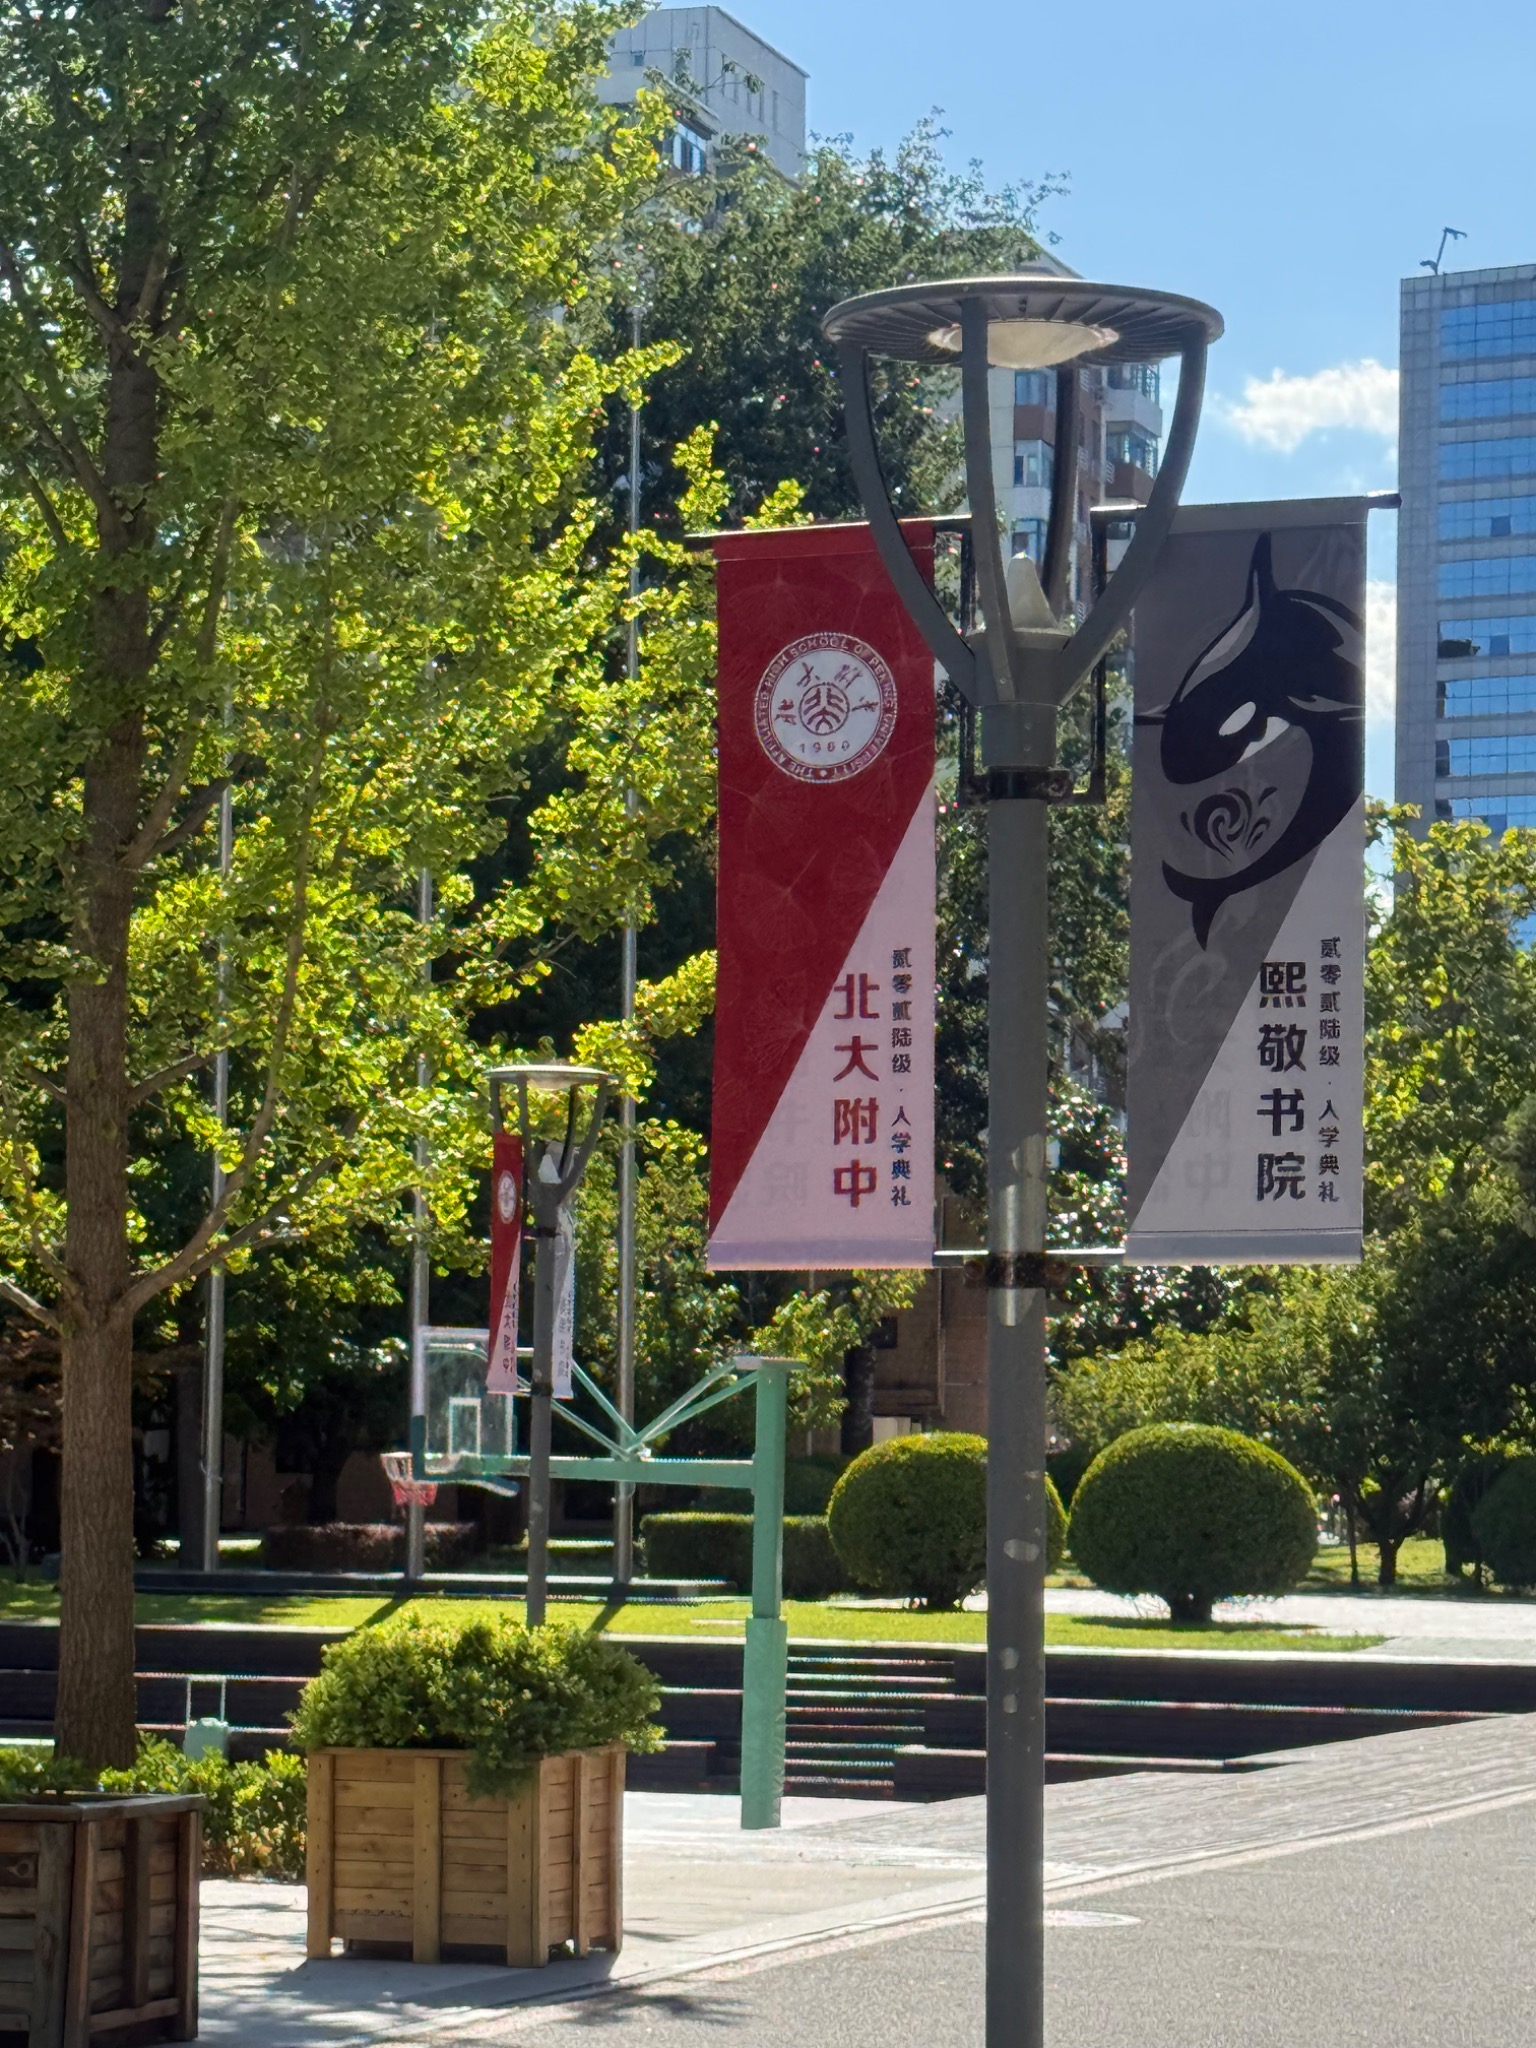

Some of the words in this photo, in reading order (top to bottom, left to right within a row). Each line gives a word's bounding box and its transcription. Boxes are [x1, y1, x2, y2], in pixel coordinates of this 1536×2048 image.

[833, 973, 880, 1208] 北大附中
[1257, 962, 1307, 1202] 熙敬书院
